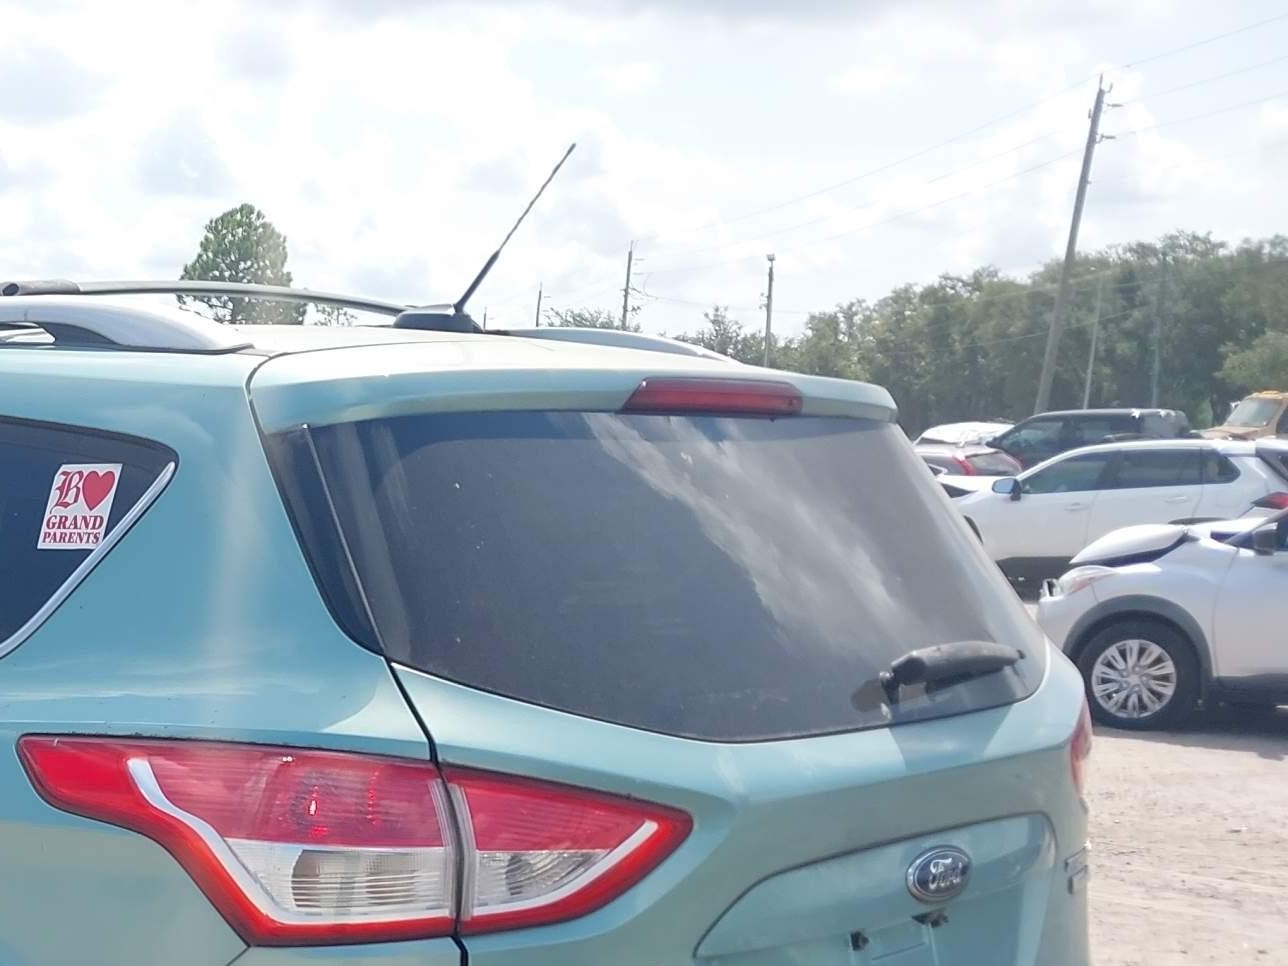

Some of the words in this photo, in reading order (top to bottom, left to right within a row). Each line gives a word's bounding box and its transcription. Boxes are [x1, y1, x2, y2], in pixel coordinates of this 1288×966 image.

[50, 470, 84, 514] B
[45, 514, 105, 530] GRAND
[41, 531, 101, 544] PARENTS
[928, 857, 963, 890] Ford
